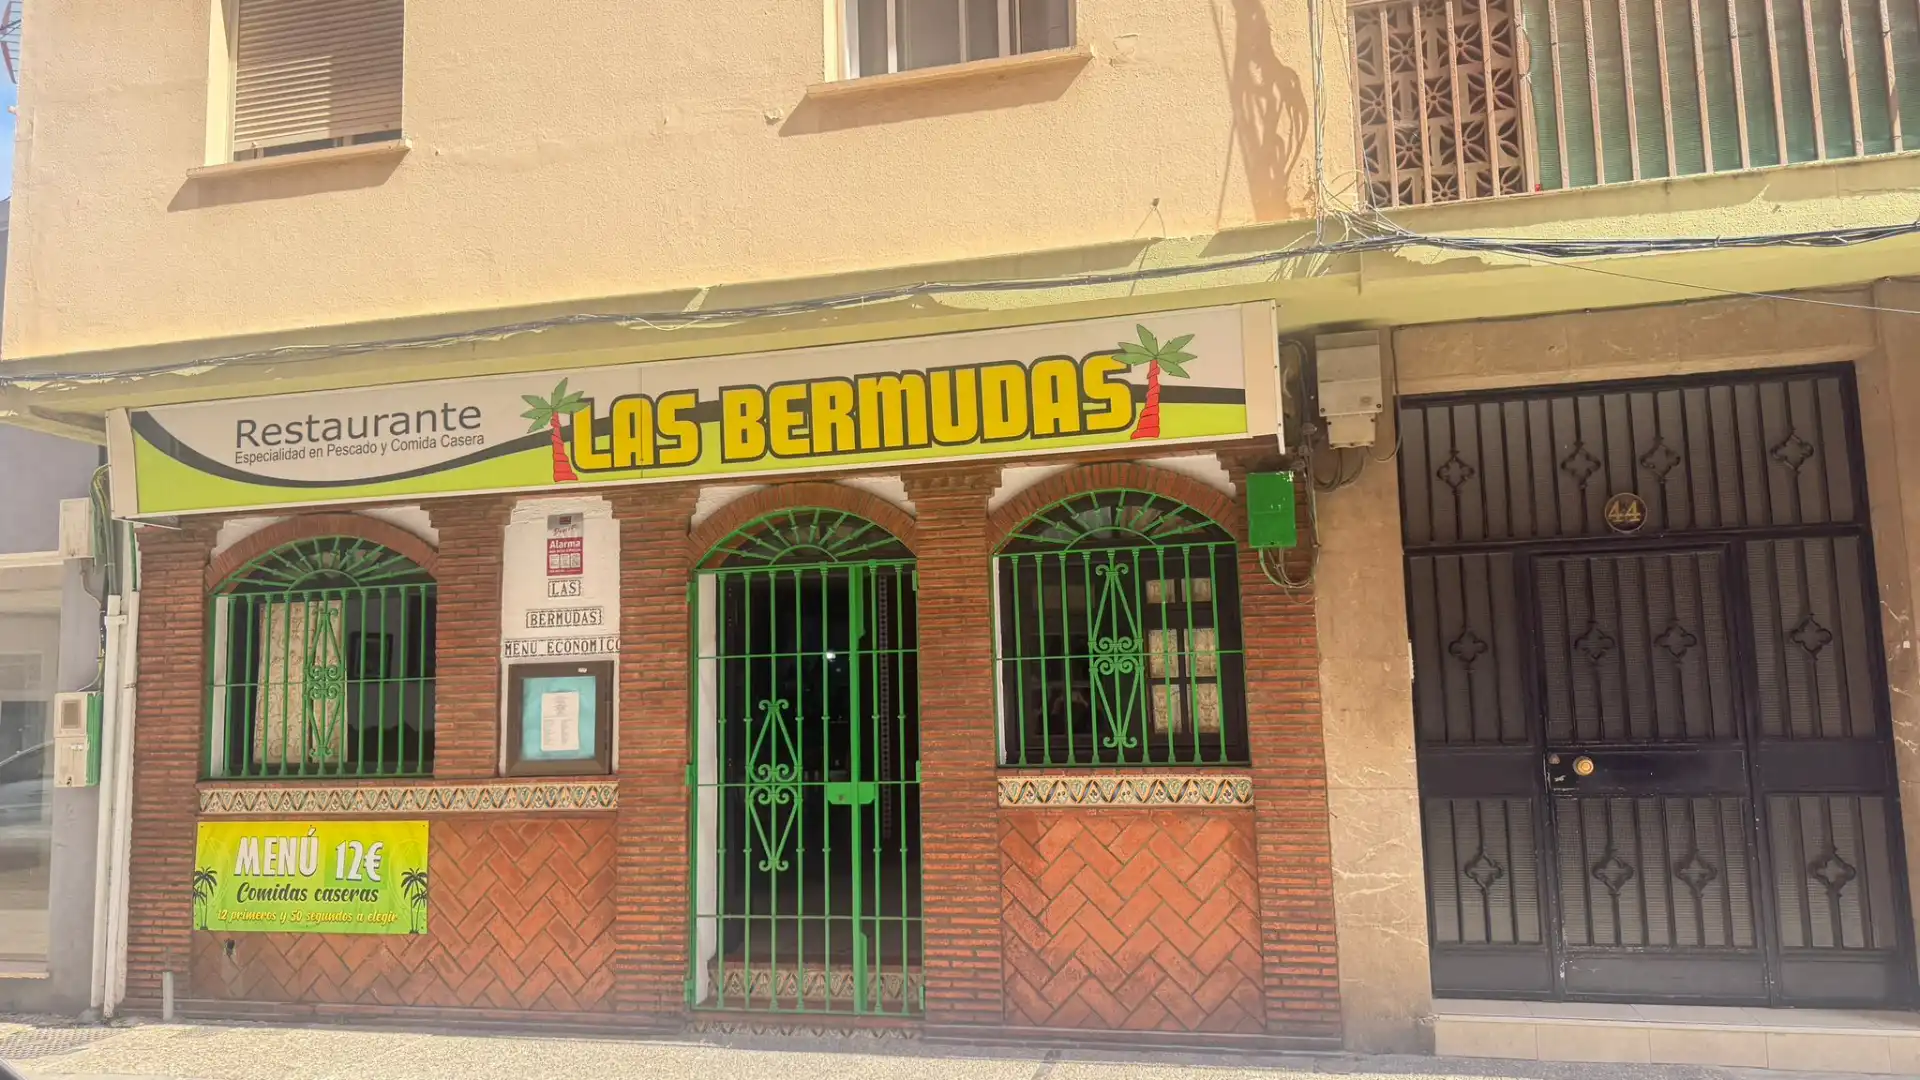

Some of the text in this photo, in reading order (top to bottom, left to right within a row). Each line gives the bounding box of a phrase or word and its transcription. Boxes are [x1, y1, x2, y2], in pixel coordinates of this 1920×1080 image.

[570, 349, 1136, 473] LAS BERMUDAS
[236, 402, 482, 448] Restaurante
[235, 433, 485, 465] Especialidad en Pescado y Comida Casera
[1608, 500, 1641, 522] 44
[549, 540, 581, 549] Alarma
[551, 582, 577, 595] LAS
[530, 611, 597, 626] BERMUDAS
[504, 642, 537, 656] MENU
[234, 827, 384, 882] MENÚ 12€
[236, 882, 379, 903] Comidas caseras
[230, 909, 276, 924] primeros
[279, 912, 287, 924] y
[306, 909, 352, 925] segundos
[356, 912, 364, 922] a
[367, 910, 397, 926] elegir
